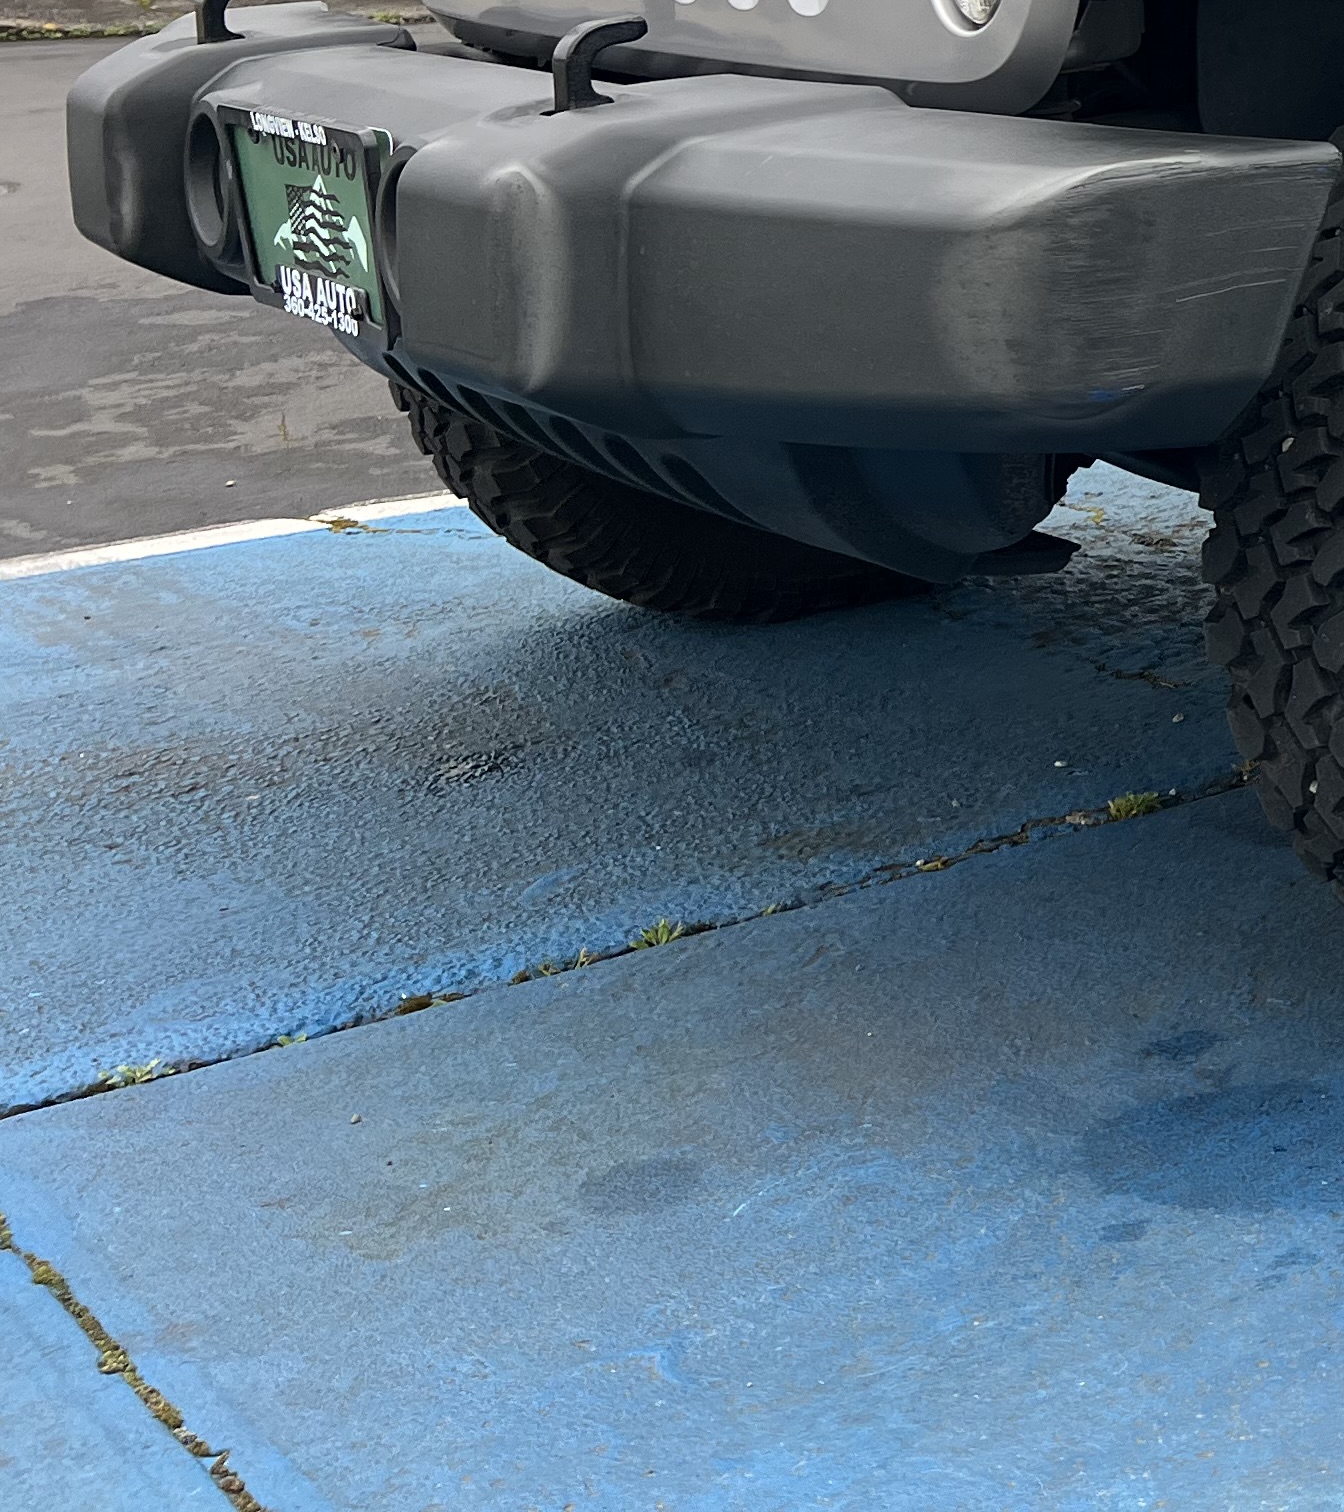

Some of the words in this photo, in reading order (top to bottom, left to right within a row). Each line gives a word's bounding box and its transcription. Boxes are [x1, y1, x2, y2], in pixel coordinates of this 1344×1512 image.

[280, 265, 314, 306] USA
[316, 277, 357, 315] AUTO
[283, 293, 359, 337] 360-425-1300
